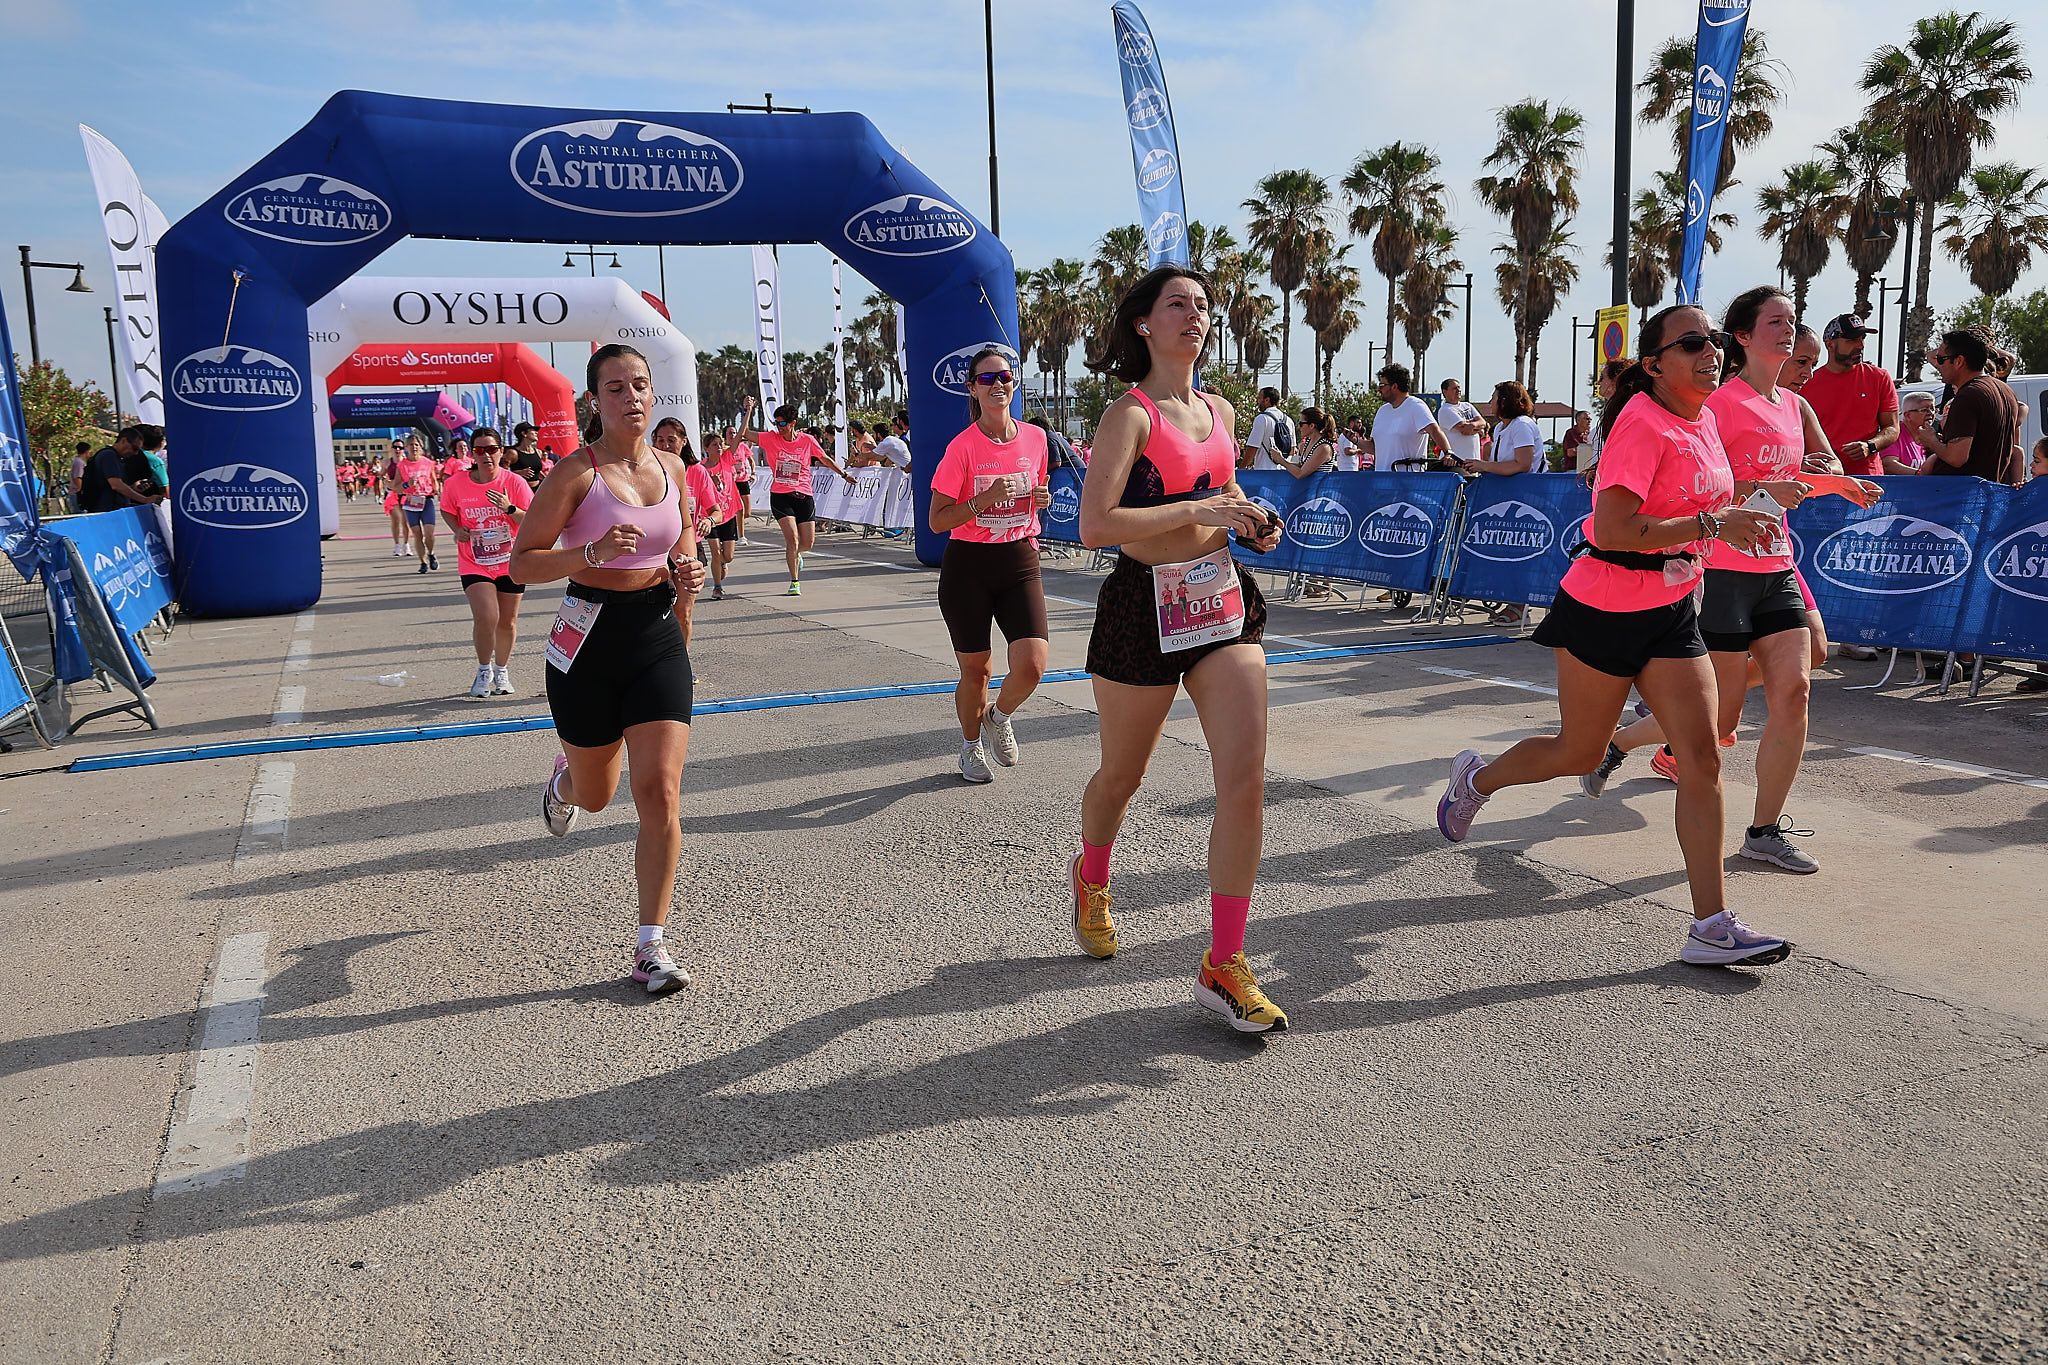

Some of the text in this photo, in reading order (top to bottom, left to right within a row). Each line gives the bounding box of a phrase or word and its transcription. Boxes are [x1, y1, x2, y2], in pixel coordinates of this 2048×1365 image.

[565, 144, 719, 160] CENTRAL LECHERA
[529, 144, 728, 193] ASTURIANA
[263, 195, 377, 211] CENTRAL LECHERA
[235, 197, 379, 231] ASTURIANA
[876, 215, 921, 225] CENTRAL
[855, 220, 971, 243] ASTURIANA
[392, 291, 569, 325] OYSHO
[617, 327, 667, 339] OYSHO
[352, 351, 494, 369] Sports Santander
[195, 367, 291, 378] CENTRAL LECHERA
[178, 369, 296, 397] ASTURIANA
[976, 461, 1000, 471] OYSHO
[186, 488, 302, 512] ASTURIANA
[1289, 514, 1345, 538] ASTURIANA
[1362, 520, 1427, 547] ASTURIANA
[1464, 521, 1545, 548] ASTURIANA
[483, 543, 501, 552] 016
[1850, 538, 1958, 551] CENTRAL LECHERA
[1823, 541, 1956, 576] ASTURIANA
[1163, 571, 1183, 579] SUMA
[1189, 594, 1224, 615] 016
[1170, 626, 1191, 635] CARRERA
[1171, 634, 1201, 646] OYSHO
[1210, 974, 1244, 1020] NITRO
